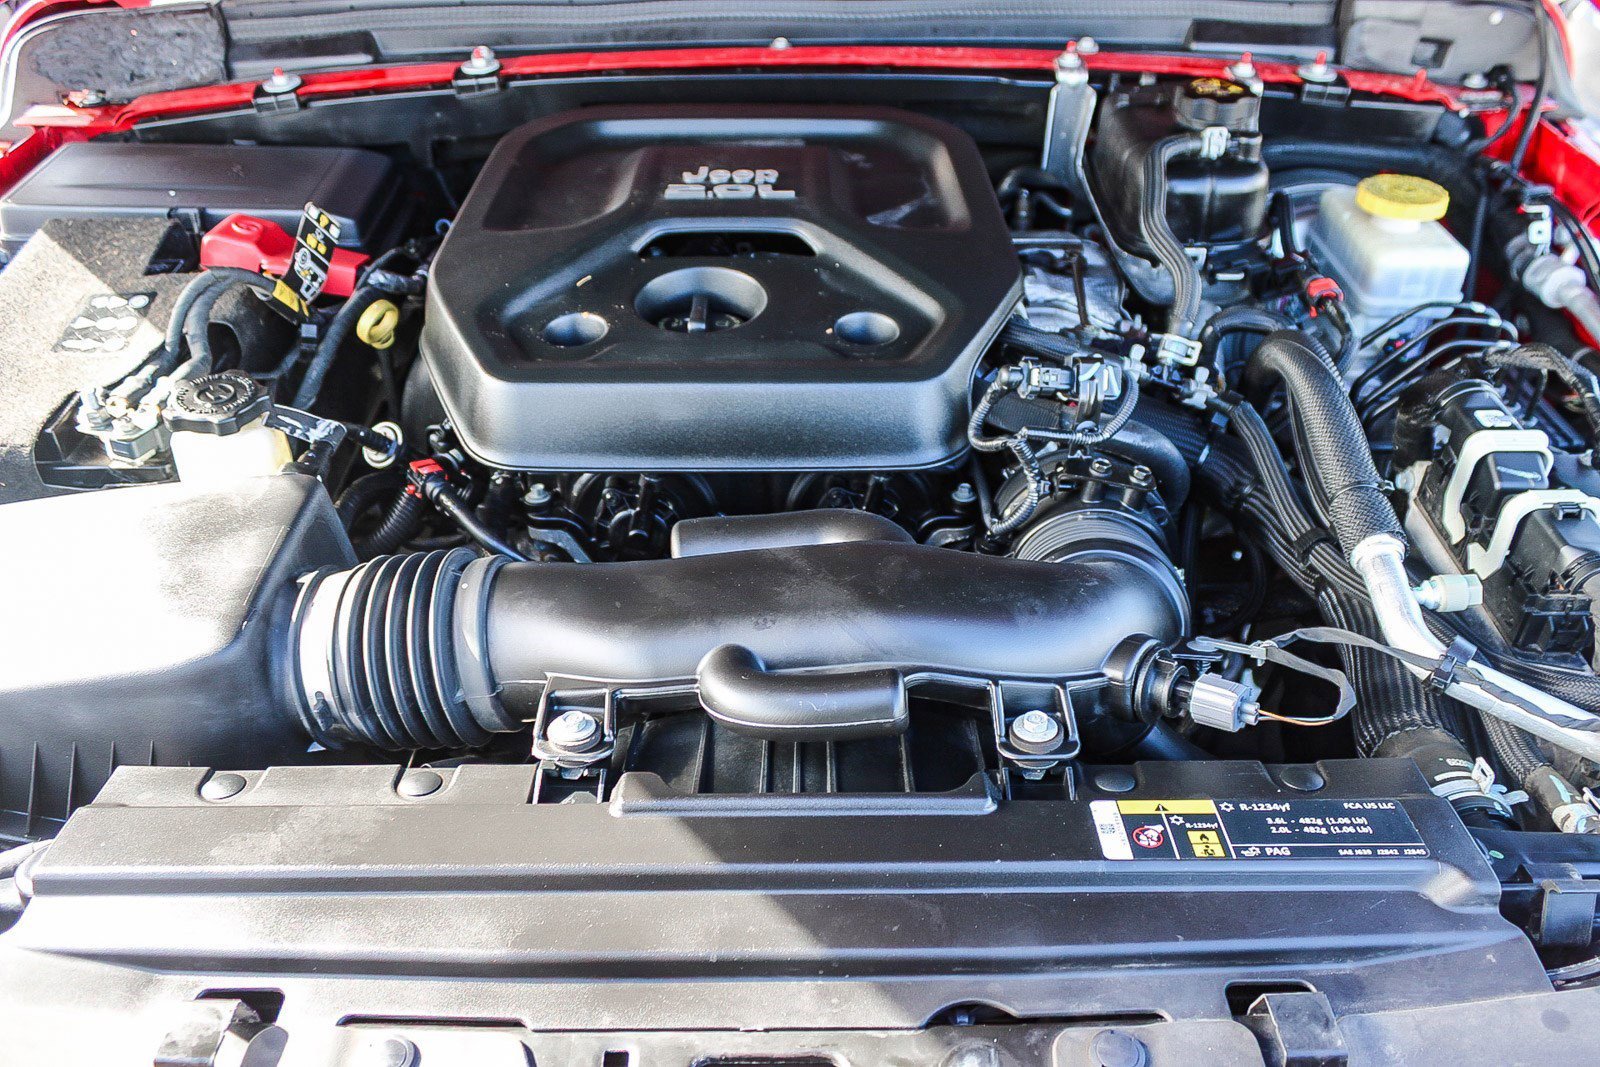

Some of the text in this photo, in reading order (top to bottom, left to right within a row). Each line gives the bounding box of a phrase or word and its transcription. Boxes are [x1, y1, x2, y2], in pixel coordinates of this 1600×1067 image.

[682, 166, 779, 184] Jeep
[664, 183, 796, 200] 2.0L
[1239, 803, 1291, 812] R-1234yf
[1343, 802, 1396, 810] FCA US LLC
[1265, 846, 1291, 856] PAG
